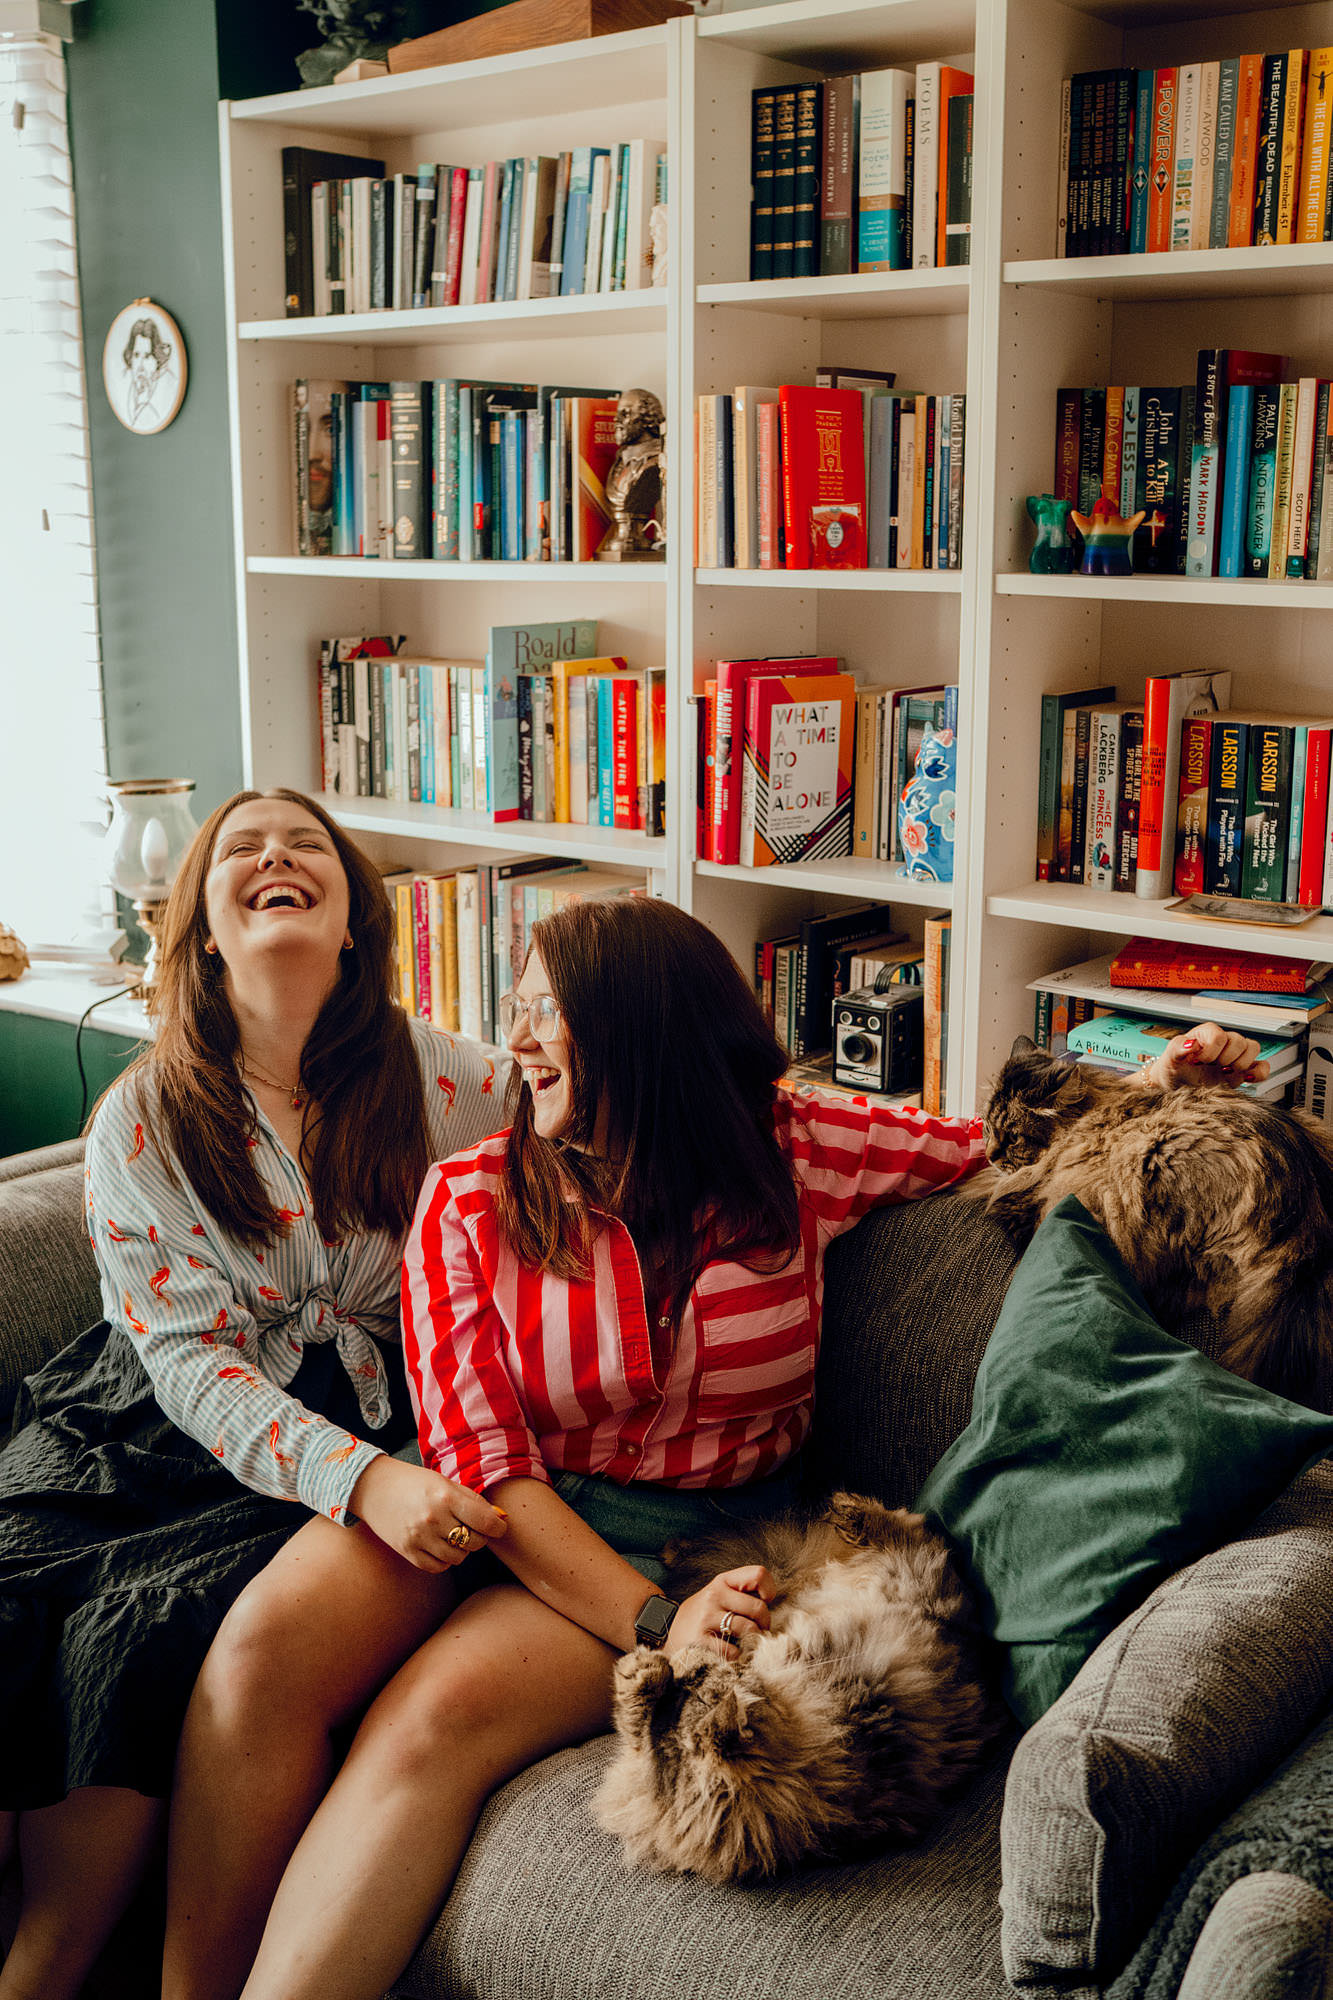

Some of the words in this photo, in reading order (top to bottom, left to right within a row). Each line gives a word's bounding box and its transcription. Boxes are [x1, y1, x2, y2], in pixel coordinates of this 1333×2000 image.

[1272, 60, 1282, 81] THE
[1106, 81, 1116, 123] DOUGLAS
[1118, 80, 1128, 124] DOUGLAS
[1205, 71, 1213, 108] MARGARET
[1221, 79, 1232, 102] MAN
[920, 76, 932, 146] POEMS
[1095, 84, 1104, 127] DOUGLAS
[1183, 87, 1193, 133] MONICA
[1268, 84, 1280, 141] BEAUTIFUL
[1287, 81, 1298, 133] BRADBURY
[1313, 102, 1327, 122] THE
[828, 90, 836, 152] ANTHOLOGY
[1156, 88, 1173, 160] POWER
[1219, 104, 1230, 140] CALLED
[1312, 123, 1325, 144] GIRL
[1094, 131, 1104, 164] ADAMS
[1104, 128, 1114, 162] ADAMS
[1116, 128, 1127, 162] ADAMS
[1183, 139, 1192, 154] ALI
[1199, 112, 1212, 166] ATWOOD
[1217, 143, 1228, 162] OVE
[1266, 142, 1276, 173] DEAD
[1310, 147, 1323, 172] WITH
[826, 166, 834, 203] POETRY
[1174, 158, 1193, 212] BRICK
[1281, 165, 1292, 210] Fahrenheit
[1309, 174, 1321, 192] ALL
[1308, 193, 1320, 211] THE
[1263, 209, 1271, 232] BAUER
[1279, 212, 1288, 230] 451
[1305, 213, 1319, 240] GIFTS
[1206, 374, 1216, 396] SPOT
[1085, 396, 1092, 404] A
[1186, 396, 1194, 416] LISA
[1204, 399, 1214, 408] of
[1318, 394, 1328, 430] SUSAN
[951, 398, 962, 432] Roald
[1064, 402, 1075, 438] Patrick
[1083, 408, 1092, 440] PLACE
[1107, 398, 1120, 437] LINDA
[1144, 398, 1160, 458] Grisham
[1159, 410, 1174, 445] John
[1255, 394, 1267, 448] HAWKINS
[1264, 404, 1276, 439] PAULA
[1283, 398, 1293, 448] ELIZABETH
[1203, 412, 1215, 448] BOTHER
[950, 437, 962, 466] Dahl
[1063, 441, 1073, 466] Gale
[1091, 427, 1100, 468] PATRICK
[1125, 431, 1136, 472] LESS
[1184, 423, 1193, 467] GENOVA
[1282, 452, 1289, 462] IS
[1316, 434, 1325, 459] HILL
[1081, 443, 1090, 486] CALLED
[1105, 441, 1118, 486] GRANT
[1146, 464, 1155, 477] to
[1158, 458, 1168, 470] A
[1199, 456, 1213, 486] MARK
[1256, 460, 1268, 488] INTO
[951, 488, 959, 513] SKIN
[1145, 480, 1156, 502] Kill
[1156, 471, 1168, 504] Time
[1182, 477, 1190, 505] STILL
[1255, 490, 1266, 510] THE
[1279, 466, 1290, 509] MISSING
[1196, 491, 1209, 535] HADDON
[1295, 492, 1303, 522] SCOTT
[1180, 511, 1189, 541] ALICE
[1253, 515, 1264, 550] WATER
[1293, 527, 1302, 550] HEIM
[512, 627, 576, 670] Roald
[723, 688, 732, 704] THE
[618, 699, 627, 732] AFTER
[722, 705, 732, 738] RACHEL
[775, 706, 828, 726] WHAT
[1078, 717, 1086, 740] INTO
[618, 740, 627, 758] THE
[774, 731, 786, 747] A
[796, 726, 836, 745] TIME
[774, 751, 797, 769] TO
[1077, 743, 1086, 760] THE
[1098, 725, 1108, 784] LACKBERG
[1108, 733, 1116, 776] CAMILLA
[1126, 748, 1135, 781] SPIDER'S
[1187, 726, 1205, 784] LARSSON
[1221, 729, 1239, 789] LARSSON
[1260, 731, 1279, 792] LARSSON
[618, 763, 627, 786] FIRE
[1077, 762, 1085, 787] WILD
[1134, 759, 1142, 777] GIRL
[772, 774, 793, 790] BE
[1132, 788, 1140, 801] THE
[1134, 778, 1141, 786] IN
[771, 791, 832, 812] ALONE
[1095, 789, 1105, 840] PRINCESS
[1193, 805, 1201, 819] The
[1104, 811, 1112, 828] ICE
[1184, 807, 1194, 834] Dragon
[1192, 821, 1200, 834] Girl
[1219, 809, 1228, 835] Played
[1254, 815, 1263, 848] Hornets'
[1270, 819, 1278, 833] The
[860, 832, 866, 841] 3
[1191, 835, 1199, 848] with
[1261, 821, 1269, 846] Kicked
[1269, 834, 1277, 846] Girl
[1121, 830, 1130, 880] LAGERCRANTZ
[1190, 850, 1198, 863] the
[1226, 846, 1234, 862] Who
[1252, 850, 1260, 867] Nest
[1260, 850, 1268, 862] the
[1267, 848, 1275, 866] Who
[1038, 1029, 1046, 1044] Act
[1075, 1040, 1082, 1048] A
[1086, 1041, 1099, 1052] Bit
[1102, 1046, 1130, 1059] Much
[1313, 1073, 1327, 1097] LOOK
